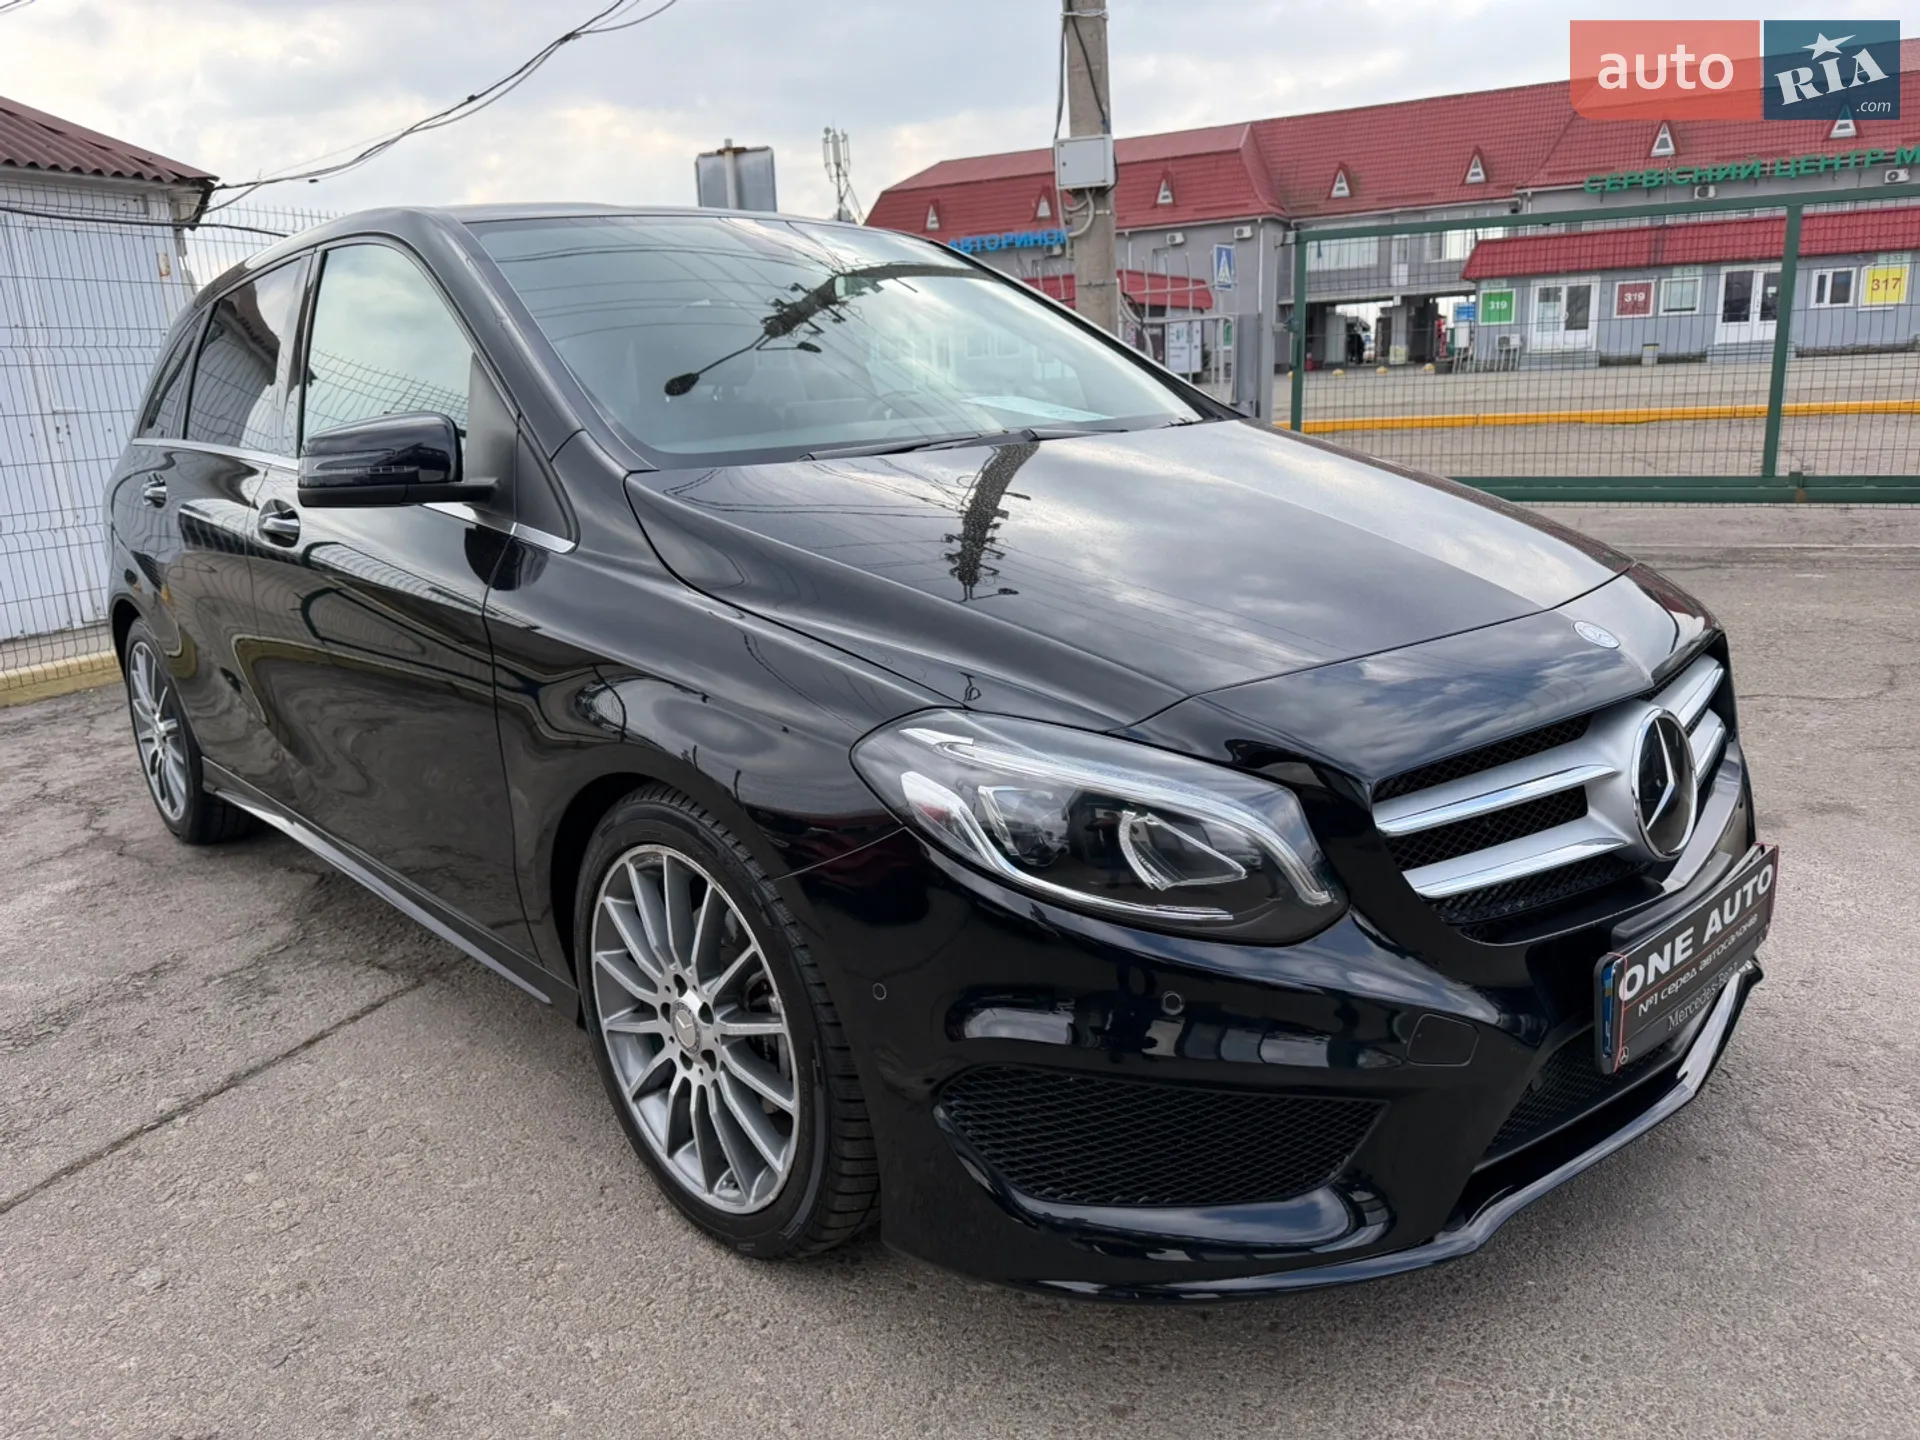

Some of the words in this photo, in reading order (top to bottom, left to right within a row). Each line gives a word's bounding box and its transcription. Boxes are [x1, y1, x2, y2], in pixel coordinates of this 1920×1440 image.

[1583, 154, 1763, 194] СЕРВІСНИЙ
[1774, 147, 1886, 179] ЦЕНТР
[1871, 277, 1902, 292] 317
[1487, 300, 1508, 311] 319
[1623, 291, 1646, 303] 319
[1619, 926, 1694, 1001] ONE
[1702, 864, 1773, 945] AUTO
[1660, 966, 1697, 999] серед
